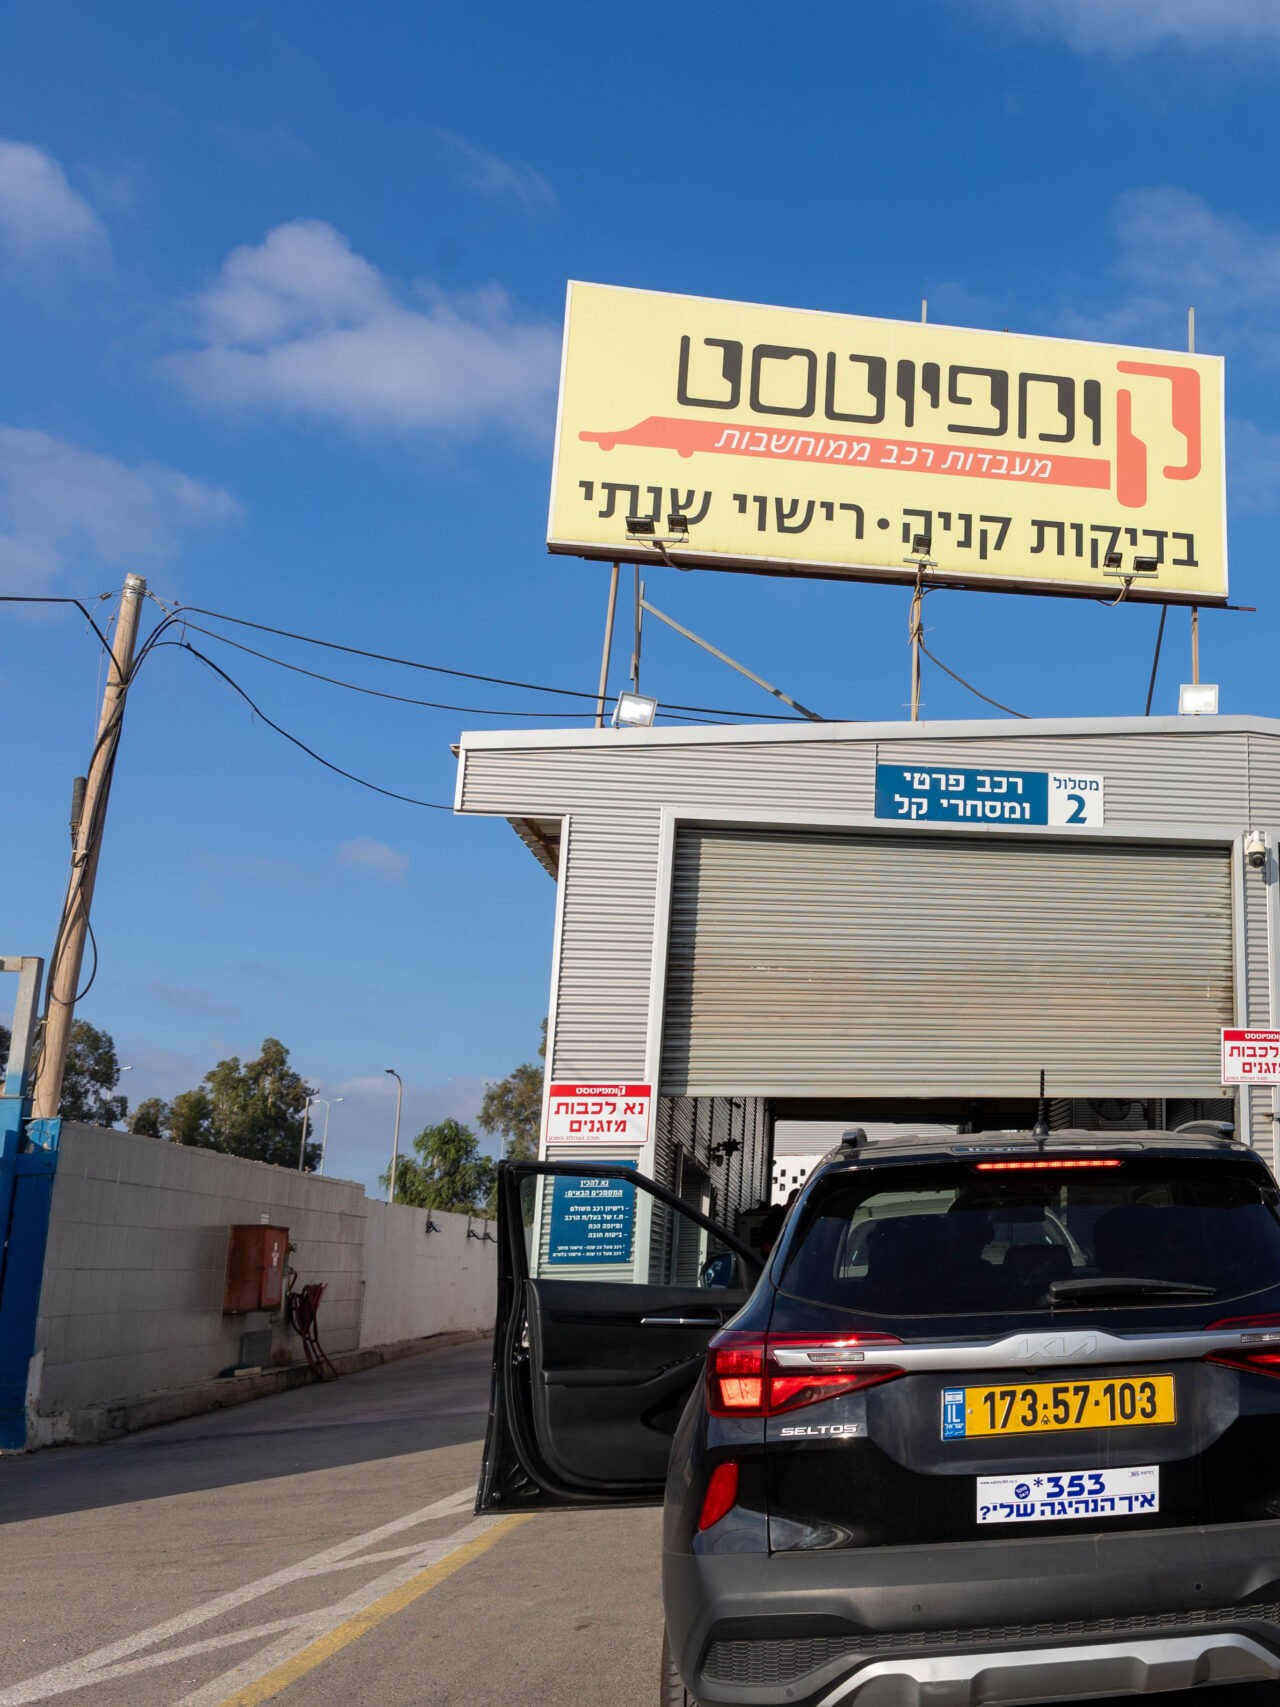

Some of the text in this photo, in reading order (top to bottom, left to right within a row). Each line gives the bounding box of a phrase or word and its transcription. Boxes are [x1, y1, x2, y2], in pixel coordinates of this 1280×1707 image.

[676, 334, 1201, 508] קומפיוטסט
[714, 428, 1053, 478] מעבדות רכב ממוחשבות
[578, 480, 1199, 568] בדיקות קניה רישוי שנתי
[902, 772, 1023, 794] רכב פרטי
[1053, 776, 1099, 791] מסלול
[894, 794, 1031, 819] ומסחרי קל
[1065, 794, 1088, 824] 2
[1229, 1046, 1279, 1058] לכבות
[554, 1101, 644, 1115] נא לכבות
[569, 1120, 627, 1132] מזגנים
[580, 1179, 599, 1187] להכין
[1017, 1336, 1098, 1360] KIA
[947, 1404, 961, 1423] IL
[780, 1424, 860, 1437] SELTOS
[979, 1494, 1155, 1520] איך הנהיגה שלי?
